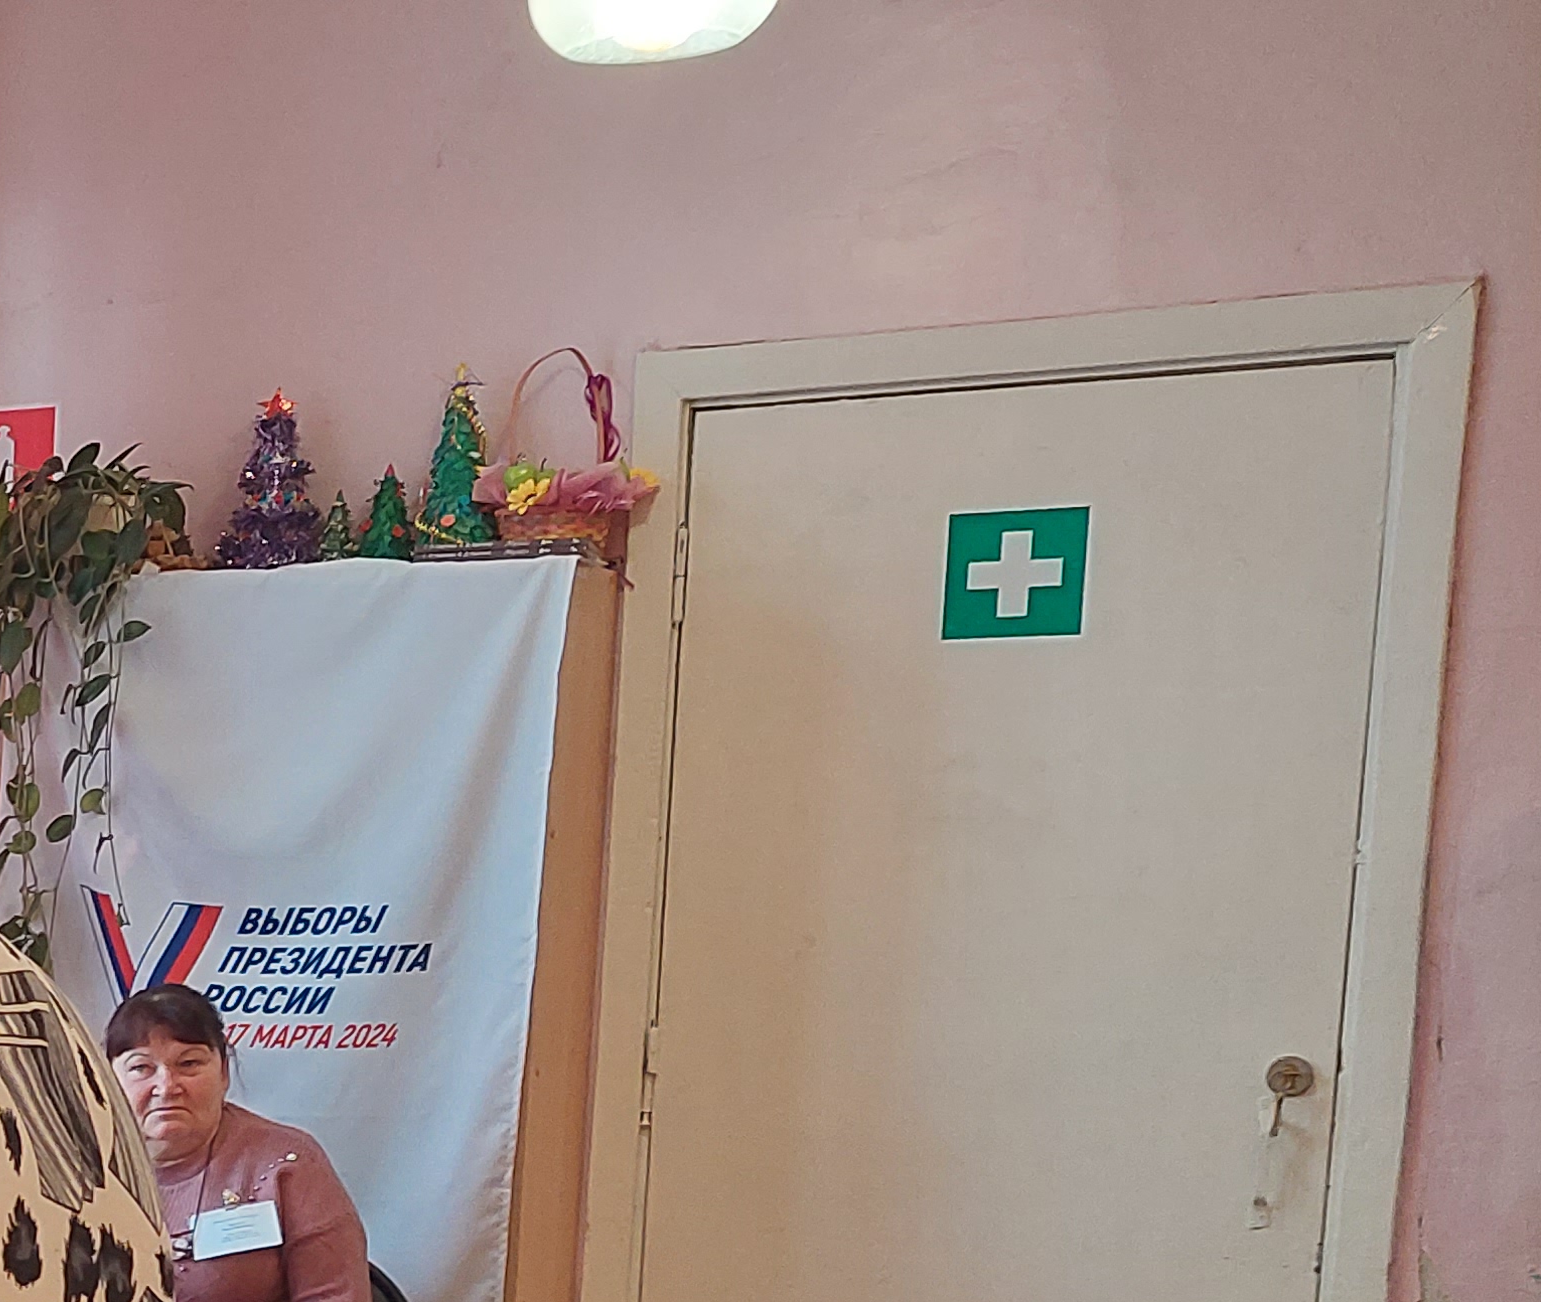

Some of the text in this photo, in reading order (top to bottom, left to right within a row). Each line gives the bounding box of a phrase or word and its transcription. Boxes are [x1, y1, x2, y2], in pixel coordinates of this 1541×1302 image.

[237, 905, 389, 936] ВЫБОРЫ
[217, 943, 433, 979] ПРЕЗИДЕНТА
[202, 983, 336, 1015] РОССИИ
[249, 1023, 332, 1049] МАРТА
[335, 1022, 399, 1049] 2024
